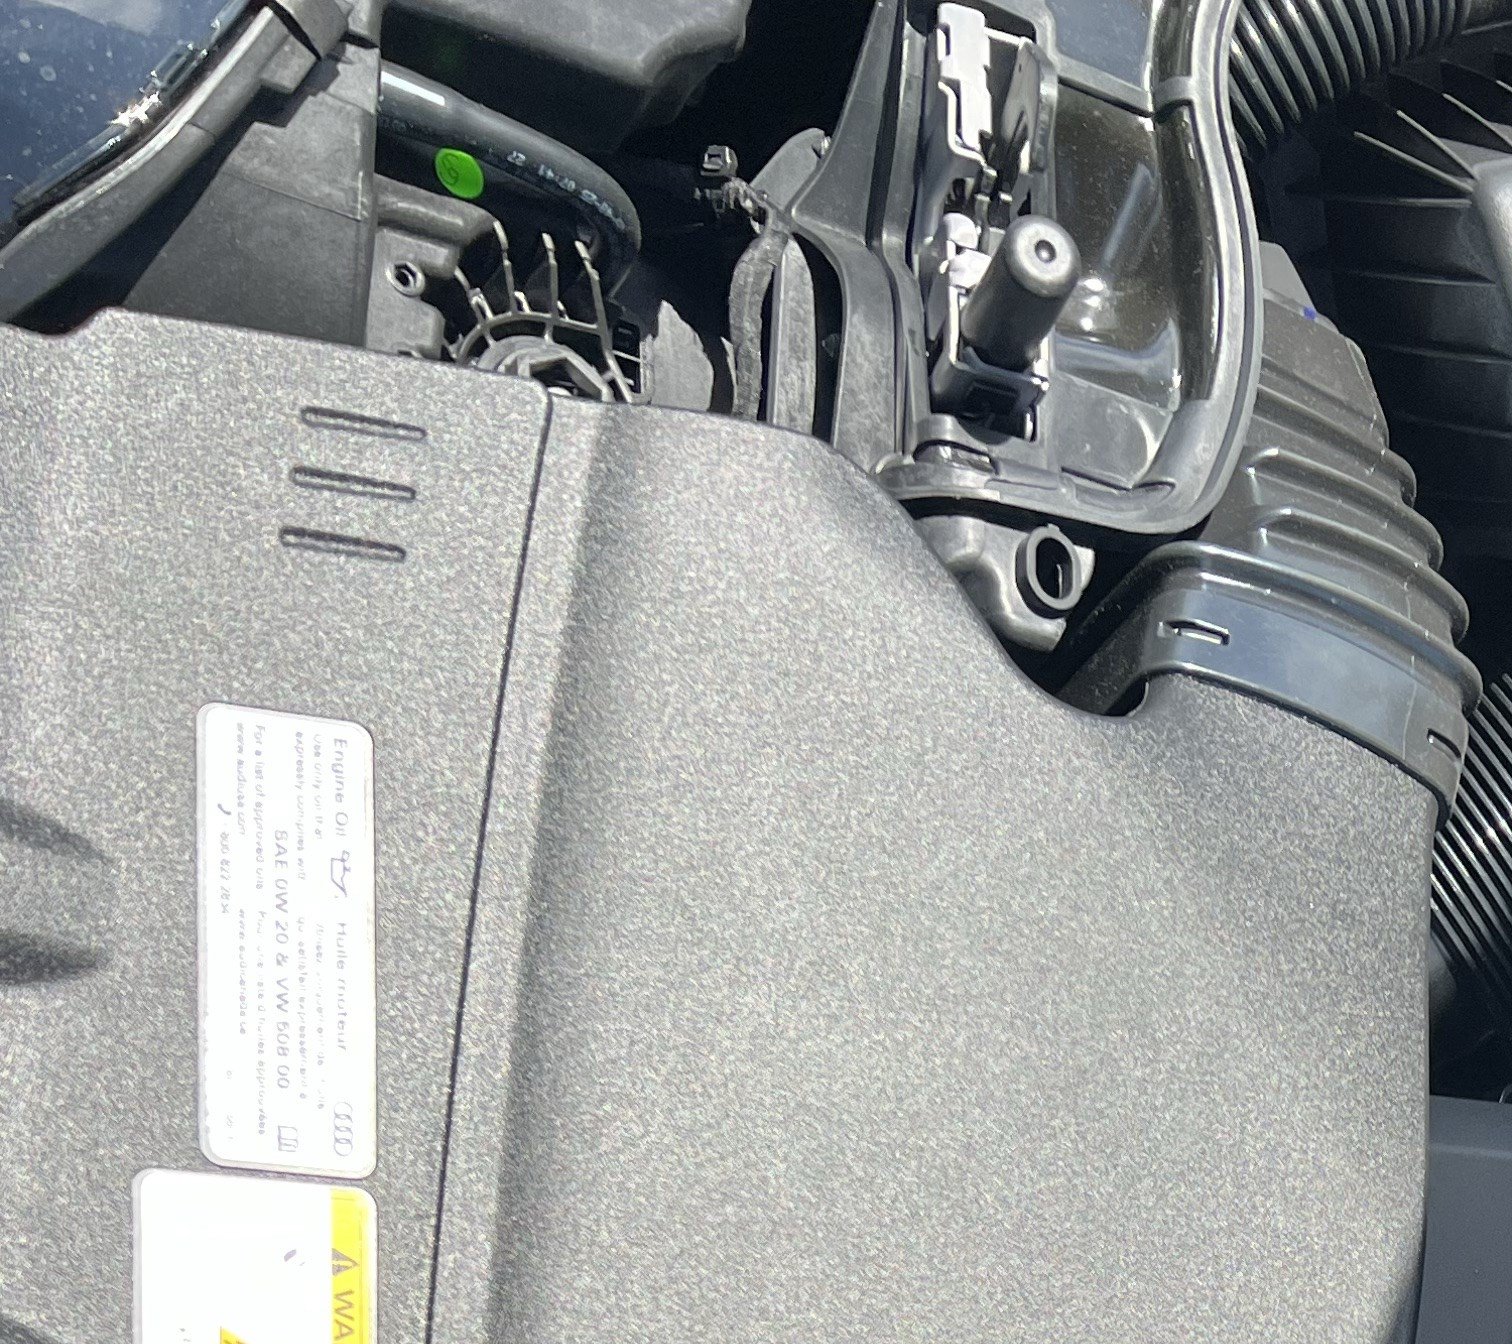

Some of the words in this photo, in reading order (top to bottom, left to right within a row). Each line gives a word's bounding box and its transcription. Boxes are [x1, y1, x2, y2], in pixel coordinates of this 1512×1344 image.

[331, 738, 348, 804] Engine
[335, 812, 349, 837] Oil
[274, 829, 288, 870] SAE
[275, 952, 289, 968] &
[336, 922, 348, 970] Huile
[276, 977, 290, 1013] VW
[337, 978, 348, 1052] moteur
[275, 1021, 290, 1058] 508
[276, 1065, 290, 1090] 00
